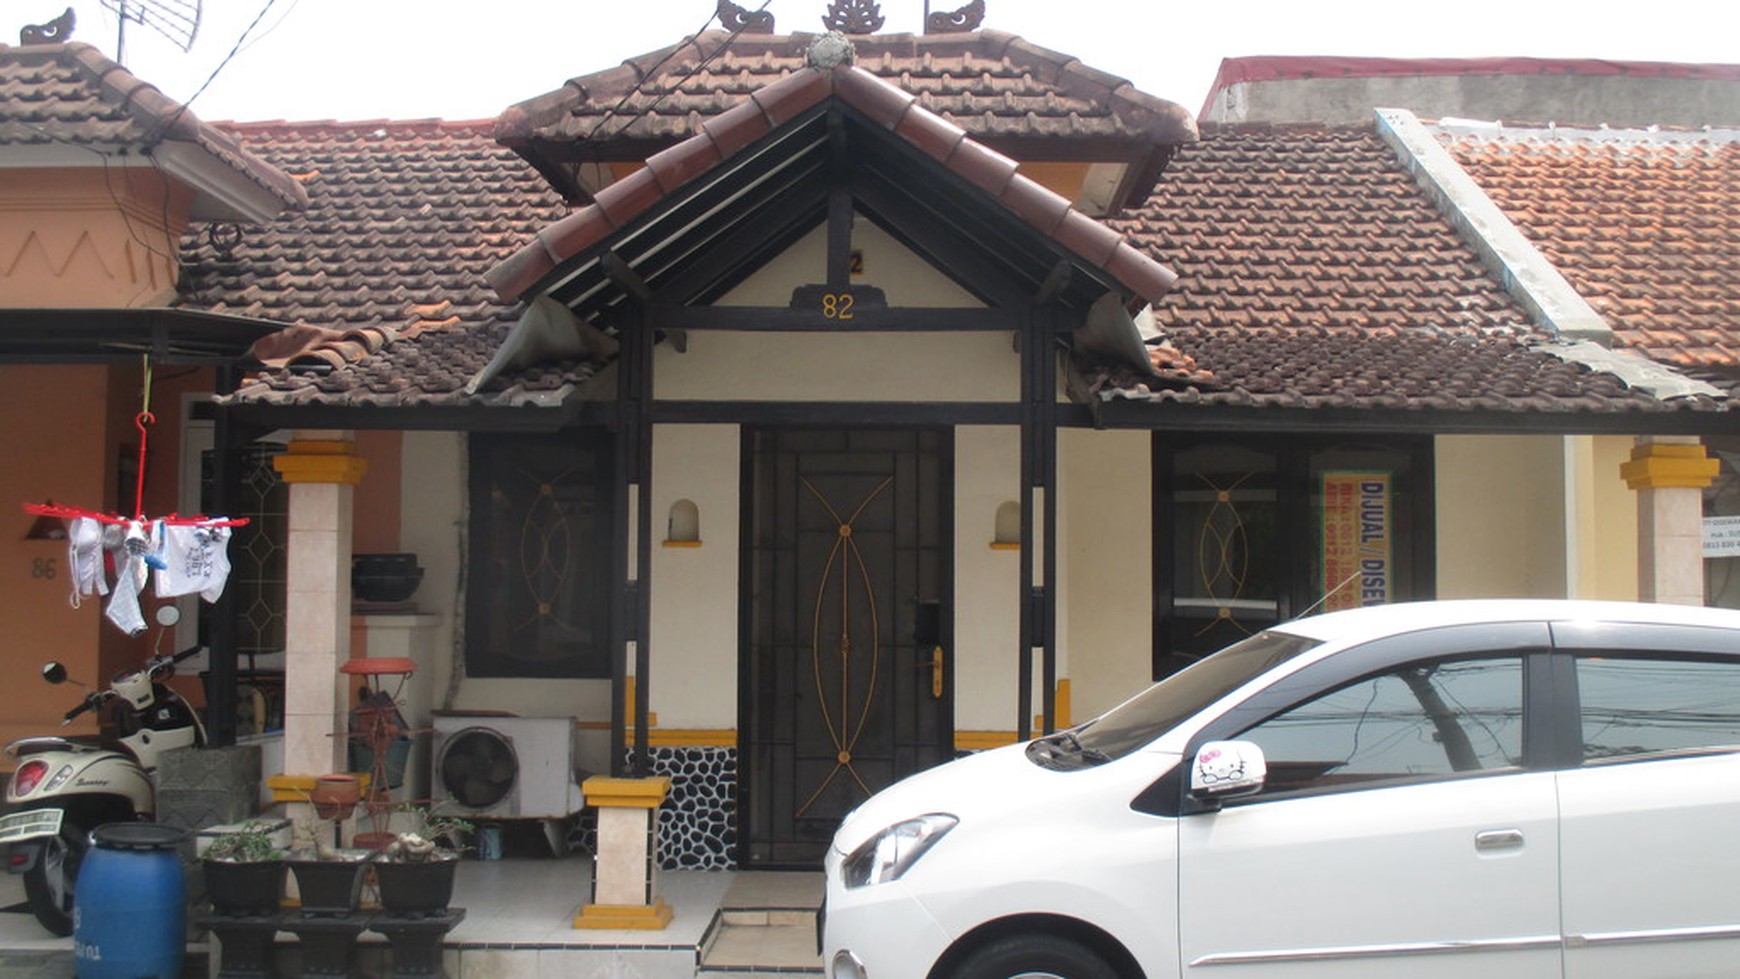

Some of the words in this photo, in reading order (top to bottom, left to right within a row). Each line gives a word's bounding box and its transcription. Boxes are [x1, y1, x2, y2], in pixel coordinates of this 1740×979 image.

[823, 294, 854, 319] 82
[1361, 482, 1384, 543] DIJUAL
[32, 558, 56, 579] 86
